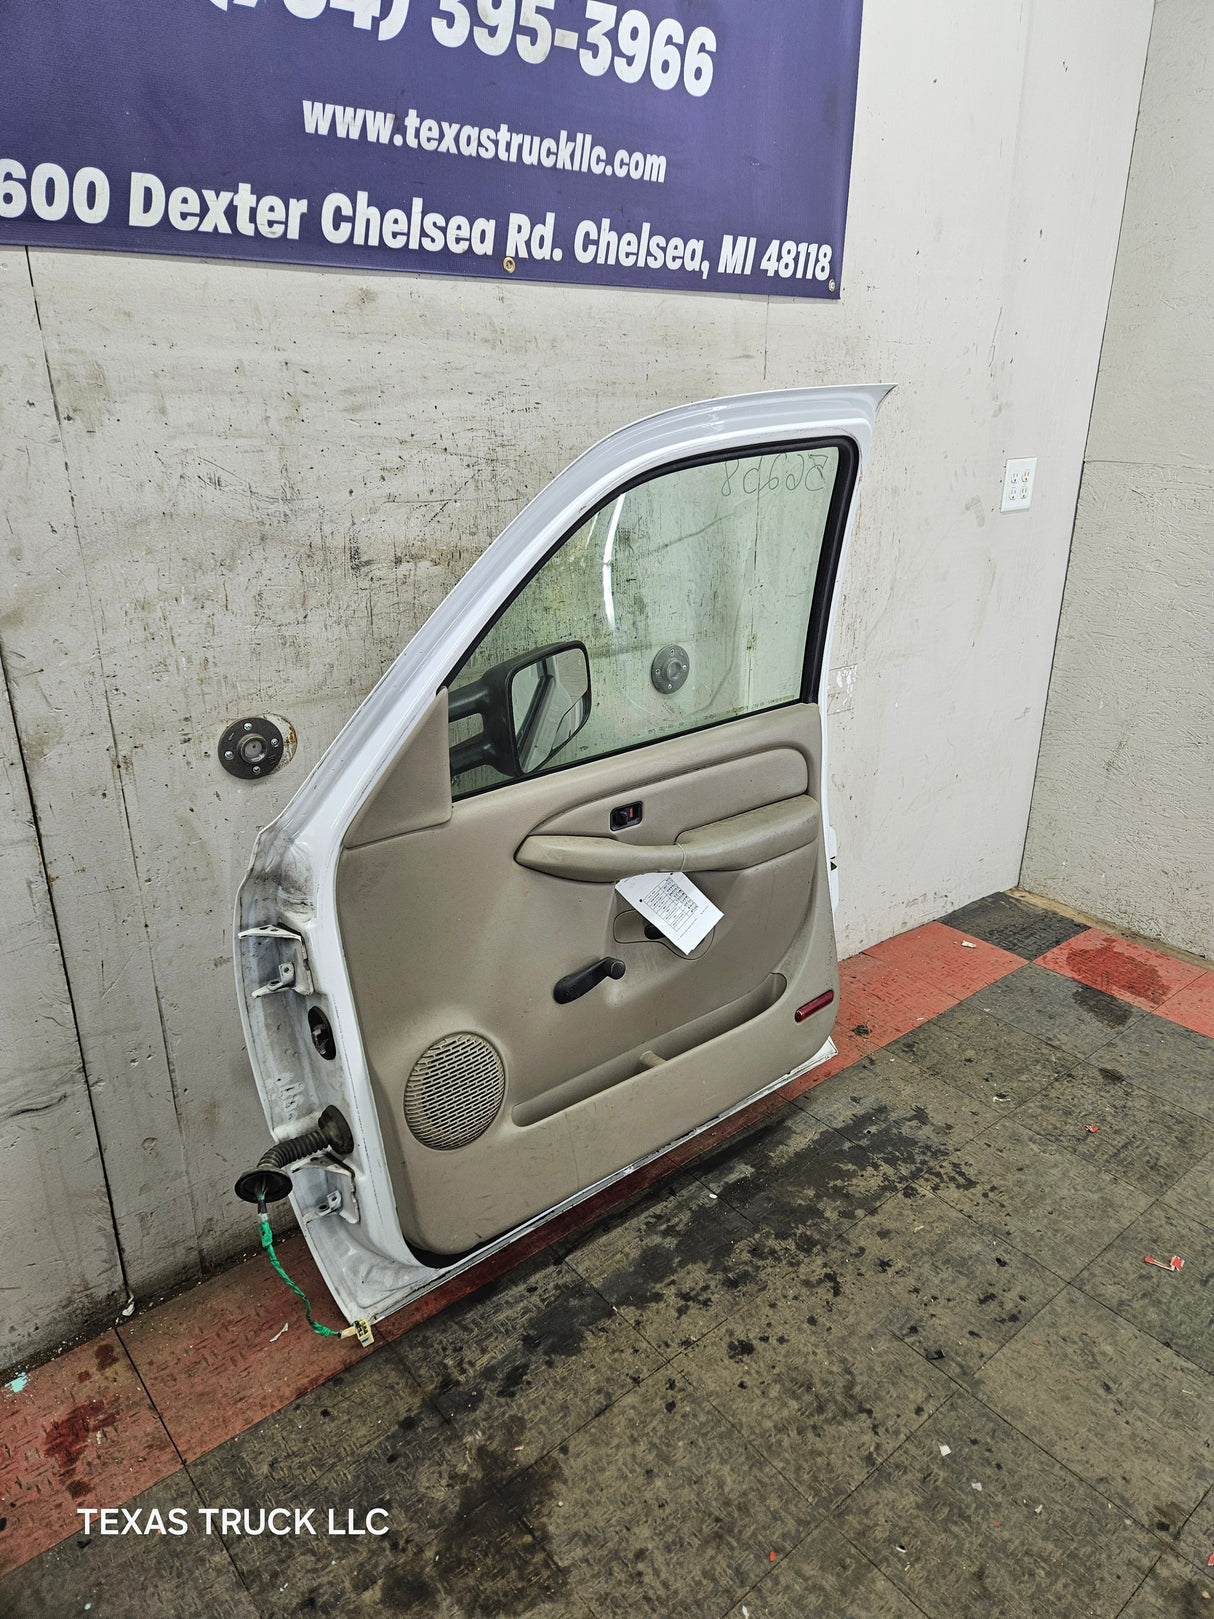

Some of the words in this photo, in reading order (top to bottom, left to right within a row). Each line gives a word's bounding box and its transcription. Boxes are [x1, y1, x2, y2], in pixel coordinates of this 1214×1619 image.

[431, 0, 717, 97] 395-3966
[302, 99, 667, 184] www.texastruckllc.com
[128, 171, 308, 240] Dexter
[321, 190, 496, 256] Chelsea
[505, 212, 563, 262] Rd.
[573, 217, 710, 280] Chelsea,
[717, 234, 757, 275] MI
[760, 239, 833, 281] 48118
